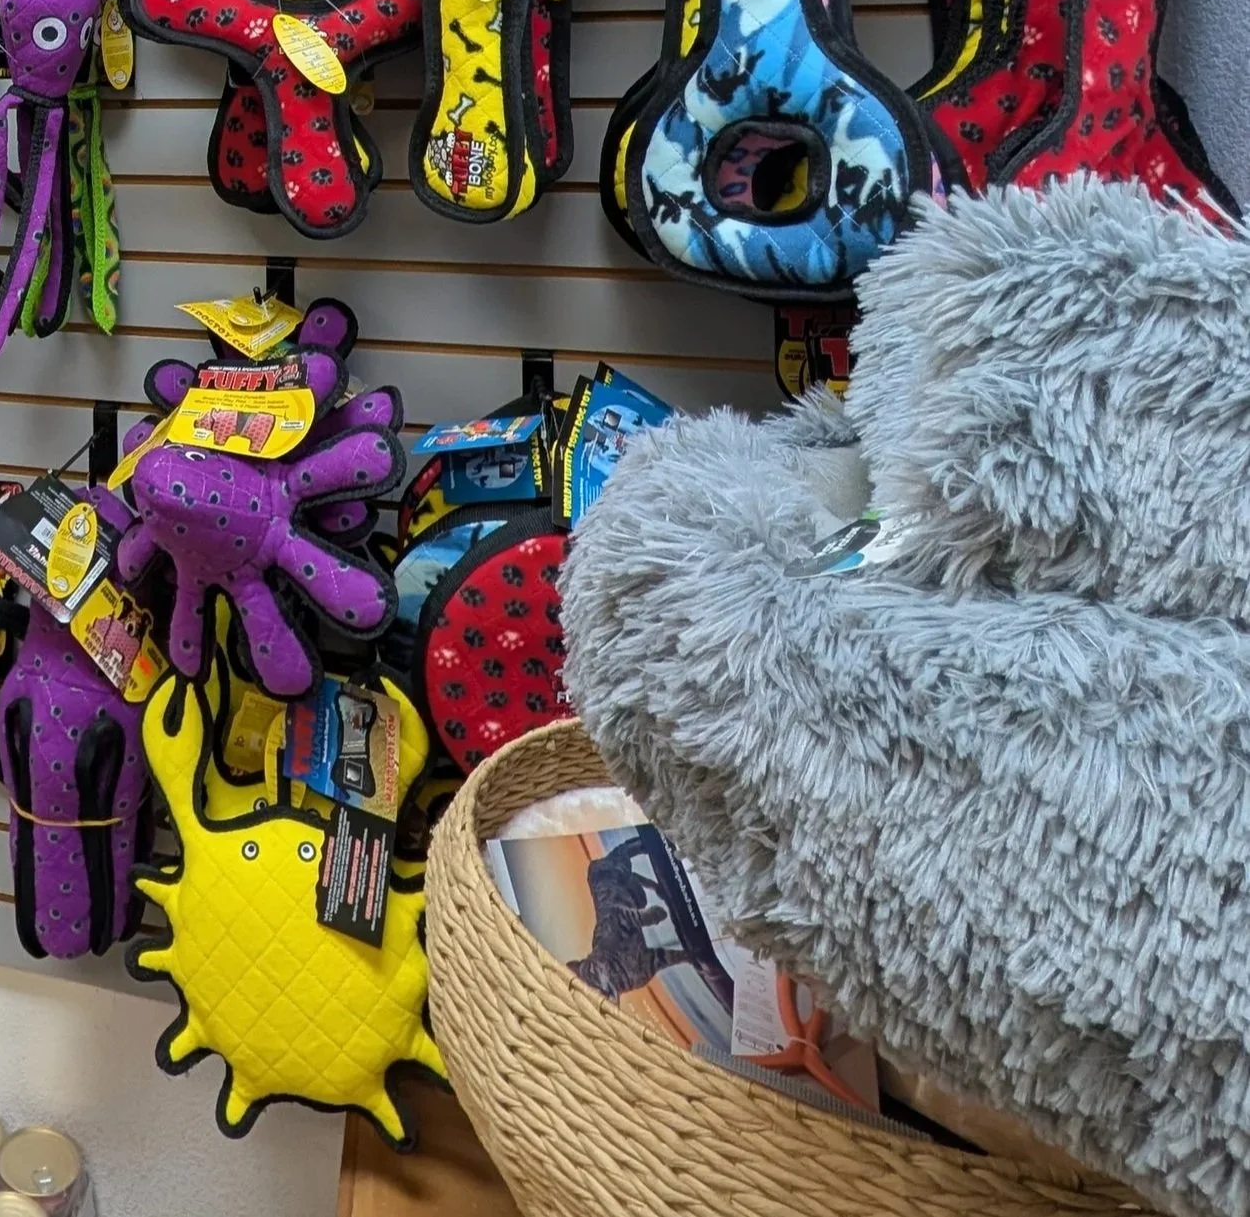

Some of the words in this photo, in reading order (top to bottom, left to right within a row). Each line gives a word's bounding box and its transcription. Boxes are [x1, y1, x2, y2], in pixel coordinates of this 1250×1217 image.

[468, 140, 485, 186] BONE
[198, 369, 284, 392] TUFFY
[574, 406, 587, 428] DOG
